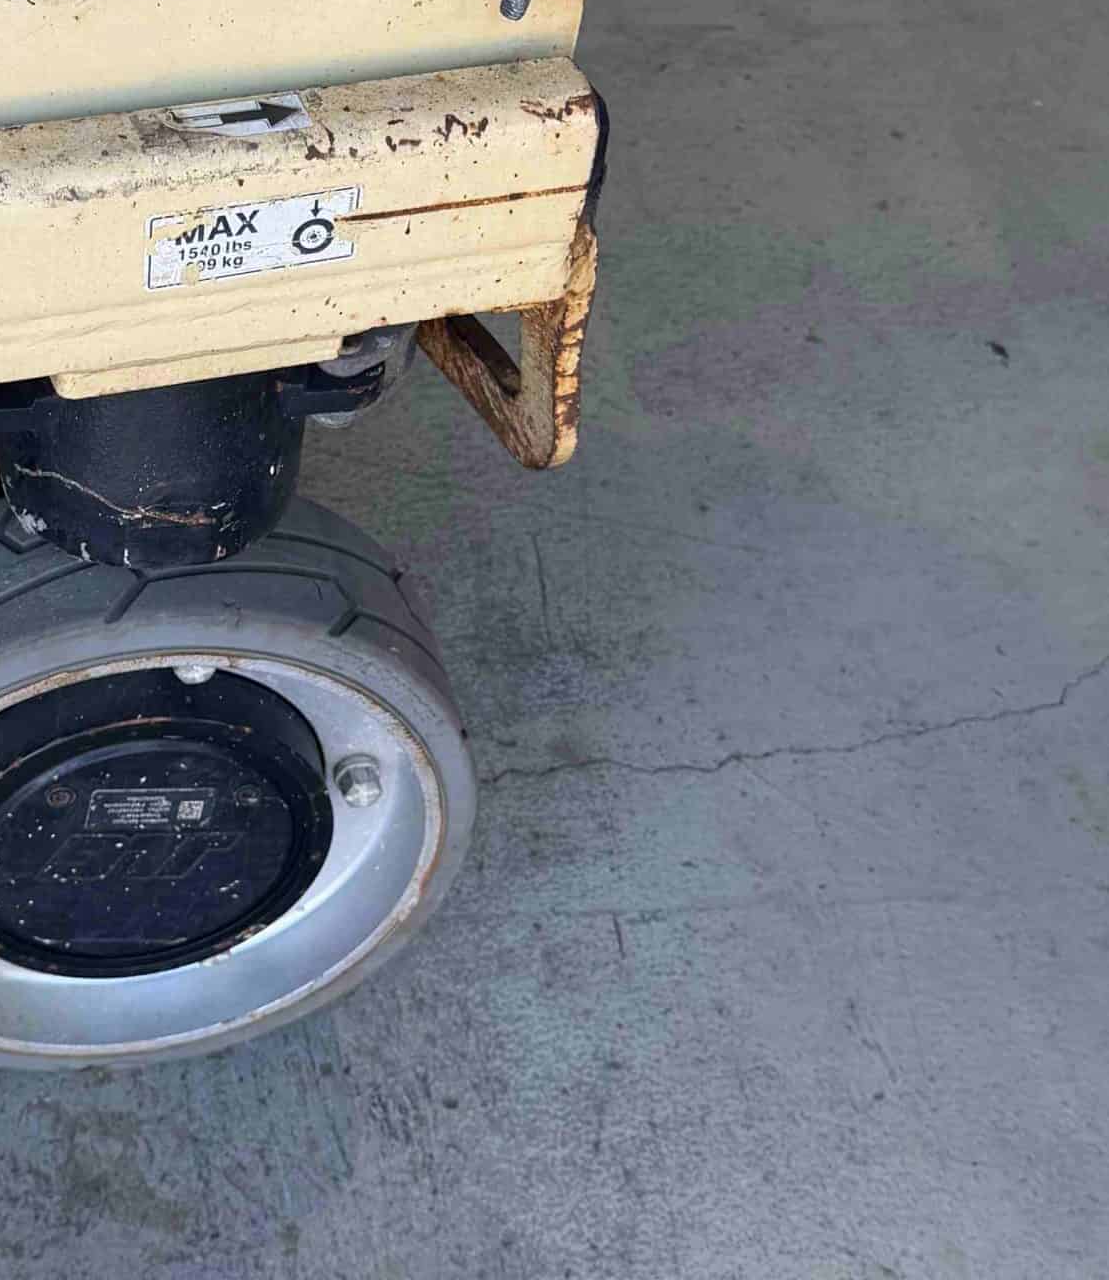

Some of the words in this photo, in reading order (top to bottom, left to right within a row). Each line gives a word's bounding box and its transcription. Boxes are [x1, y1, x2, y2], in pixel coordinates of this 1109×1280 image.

[175, 209, 260, 246] MAX
[225, 240, 252, 254] lbs
[222, 256, 244, 269] kg
